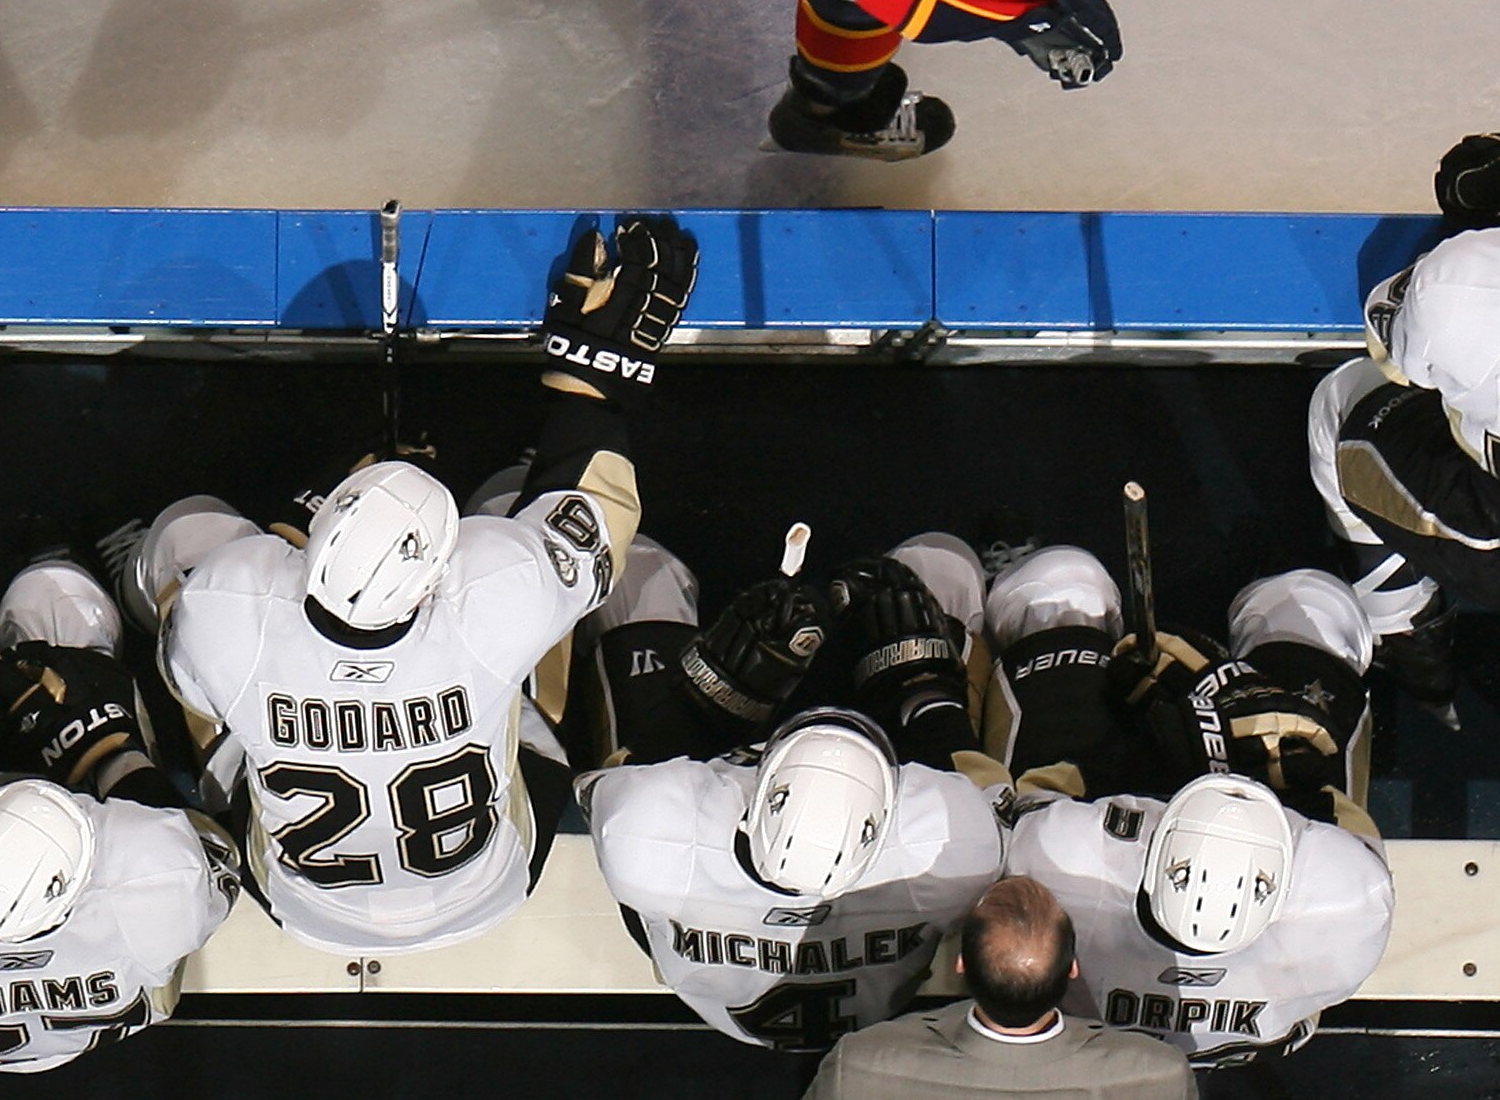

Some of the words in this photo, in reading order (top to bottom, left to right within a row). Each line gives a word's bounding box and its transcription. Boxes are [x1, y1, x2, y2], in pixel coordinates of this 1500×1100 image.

[546, 334, 656, 384] EASTO
[267, 684, 472, 752] GODARD
[257, 742, 499, 889] 28
[669, 918, 930, 975] MICHALEK
[726, 978, 857, 1051] 4
[1105, 988, 1268, 1038] ORPIK
